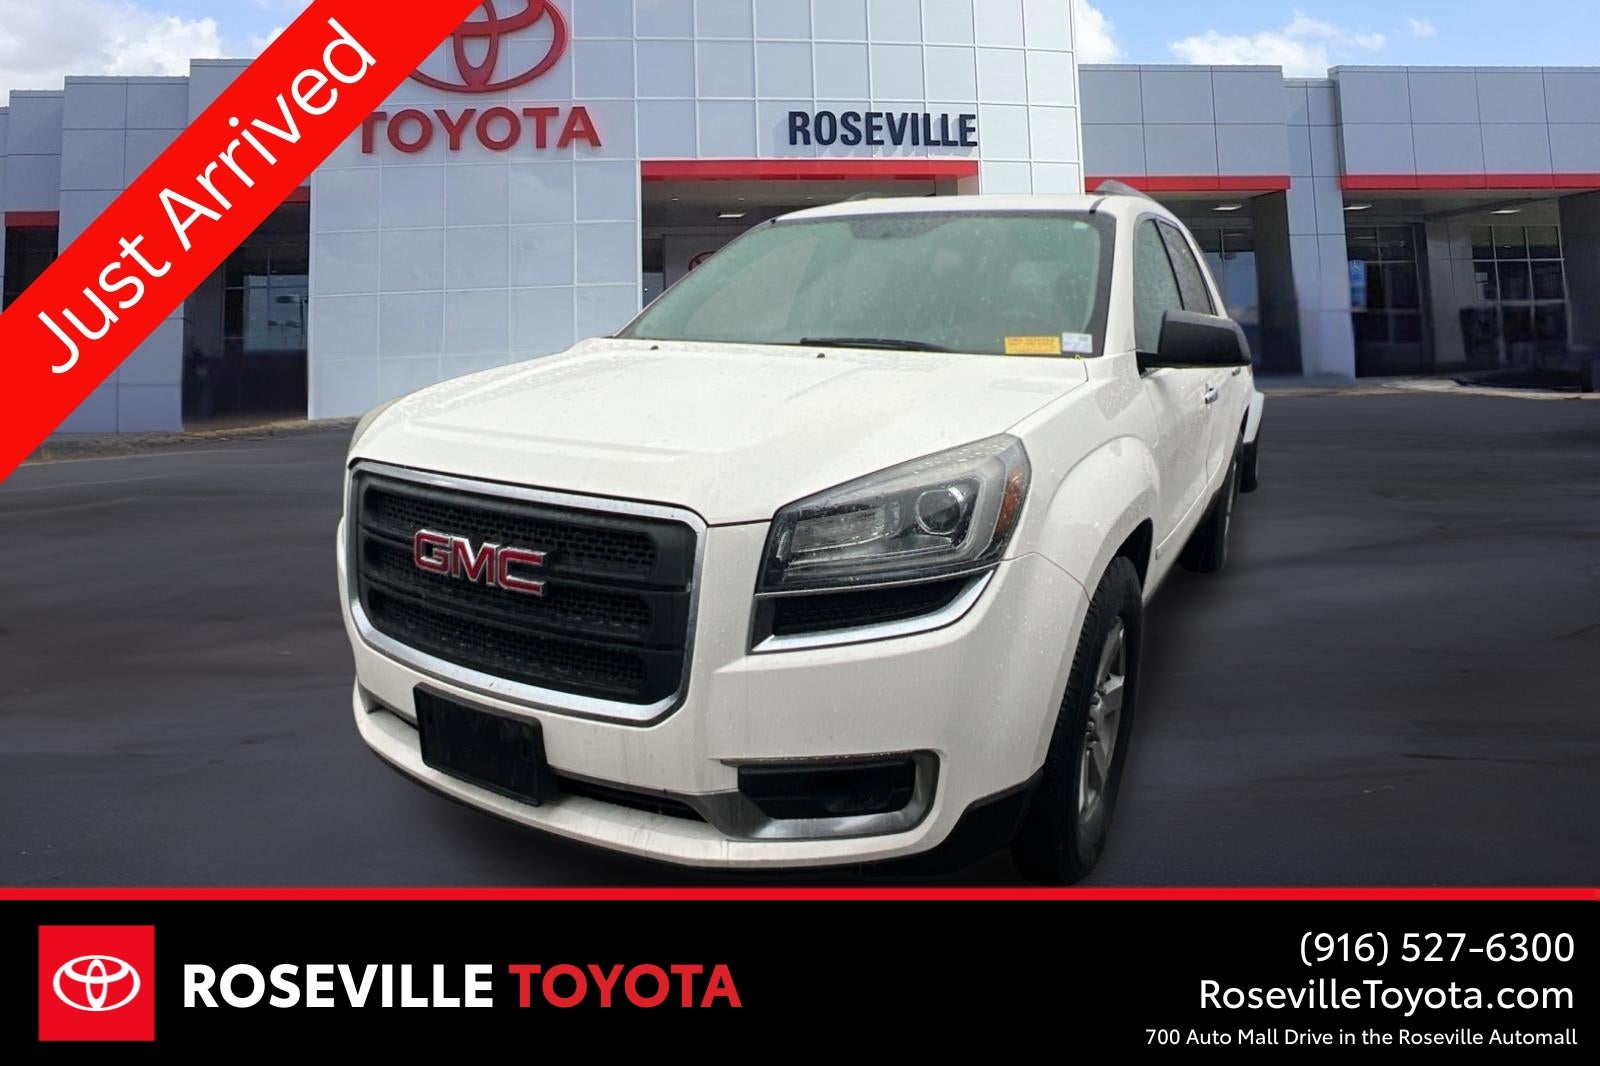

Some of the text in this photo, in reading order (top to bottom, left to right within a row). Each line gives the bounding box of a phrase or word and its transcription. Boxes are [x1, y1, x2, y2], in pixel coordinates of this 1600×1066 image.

[361, 106, 602, 154] TOYOTA
[788, 111, 978, 147] ROSEVILLE
[414, 530, 546, 596] GMC
